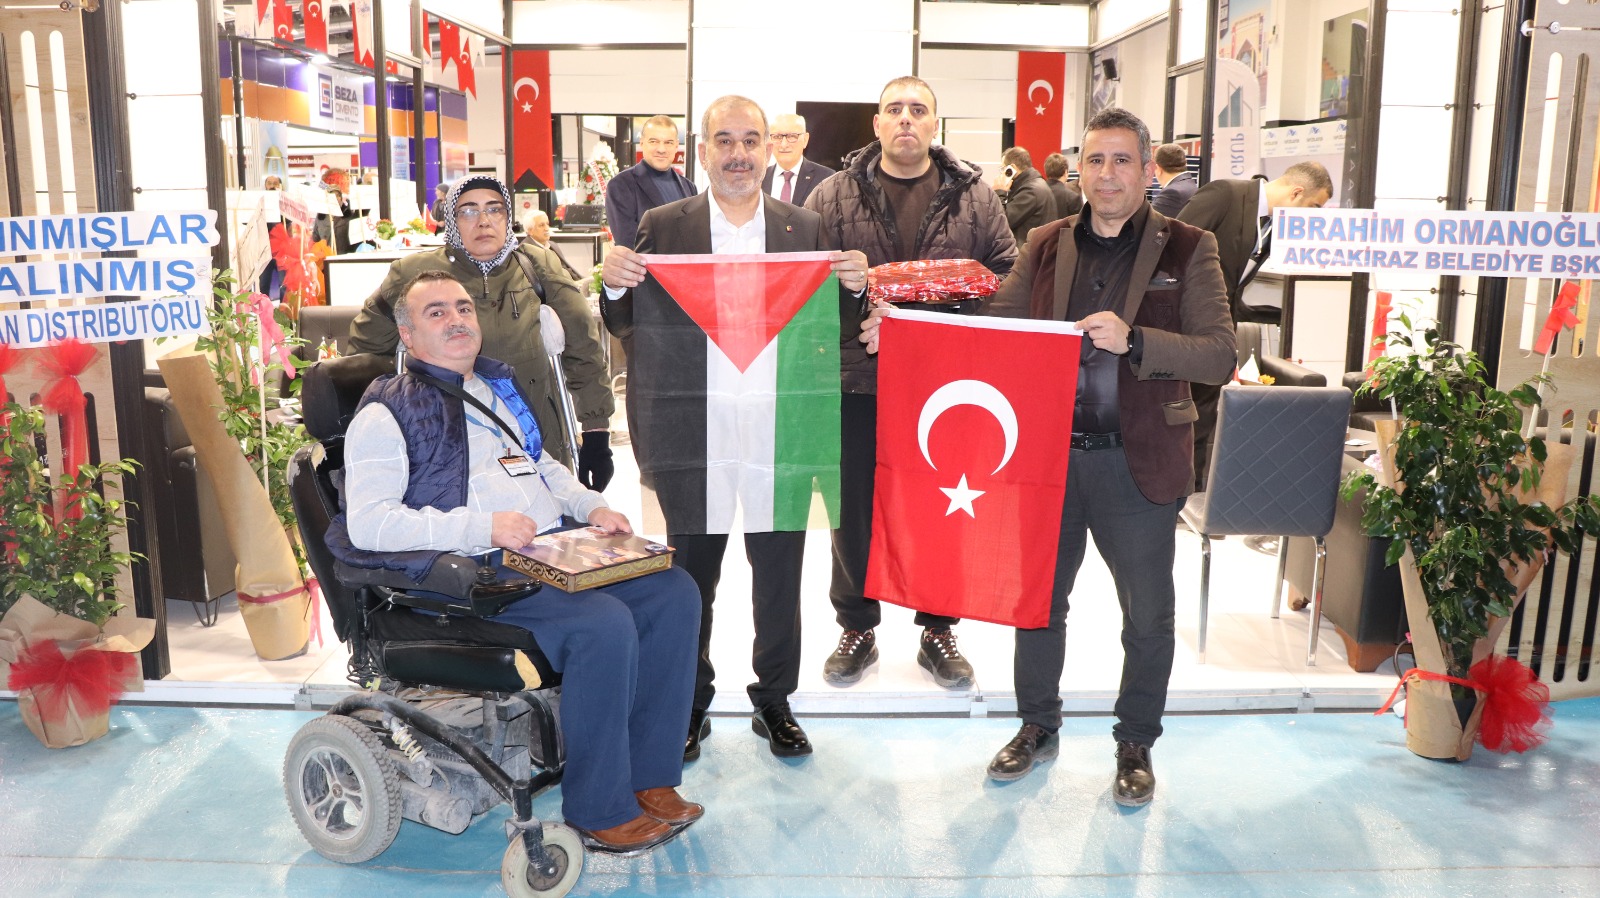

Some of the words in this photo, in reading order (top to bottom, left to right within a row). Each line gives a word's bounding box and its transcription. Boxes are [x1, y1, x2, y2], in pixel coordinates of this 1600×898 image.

[335, 86, 357, 102] SEZA
[1277, 210, 1404, 243] İBRAHİM
[1415, 215, 1600, 248] ORMANOĞL
[1283, 246, 1418, 269] AKÇAKİRAZ
[1425, 250, 1543, 273] BELEDİYE
[0, 260, 196, 296] ALINMIŞ
